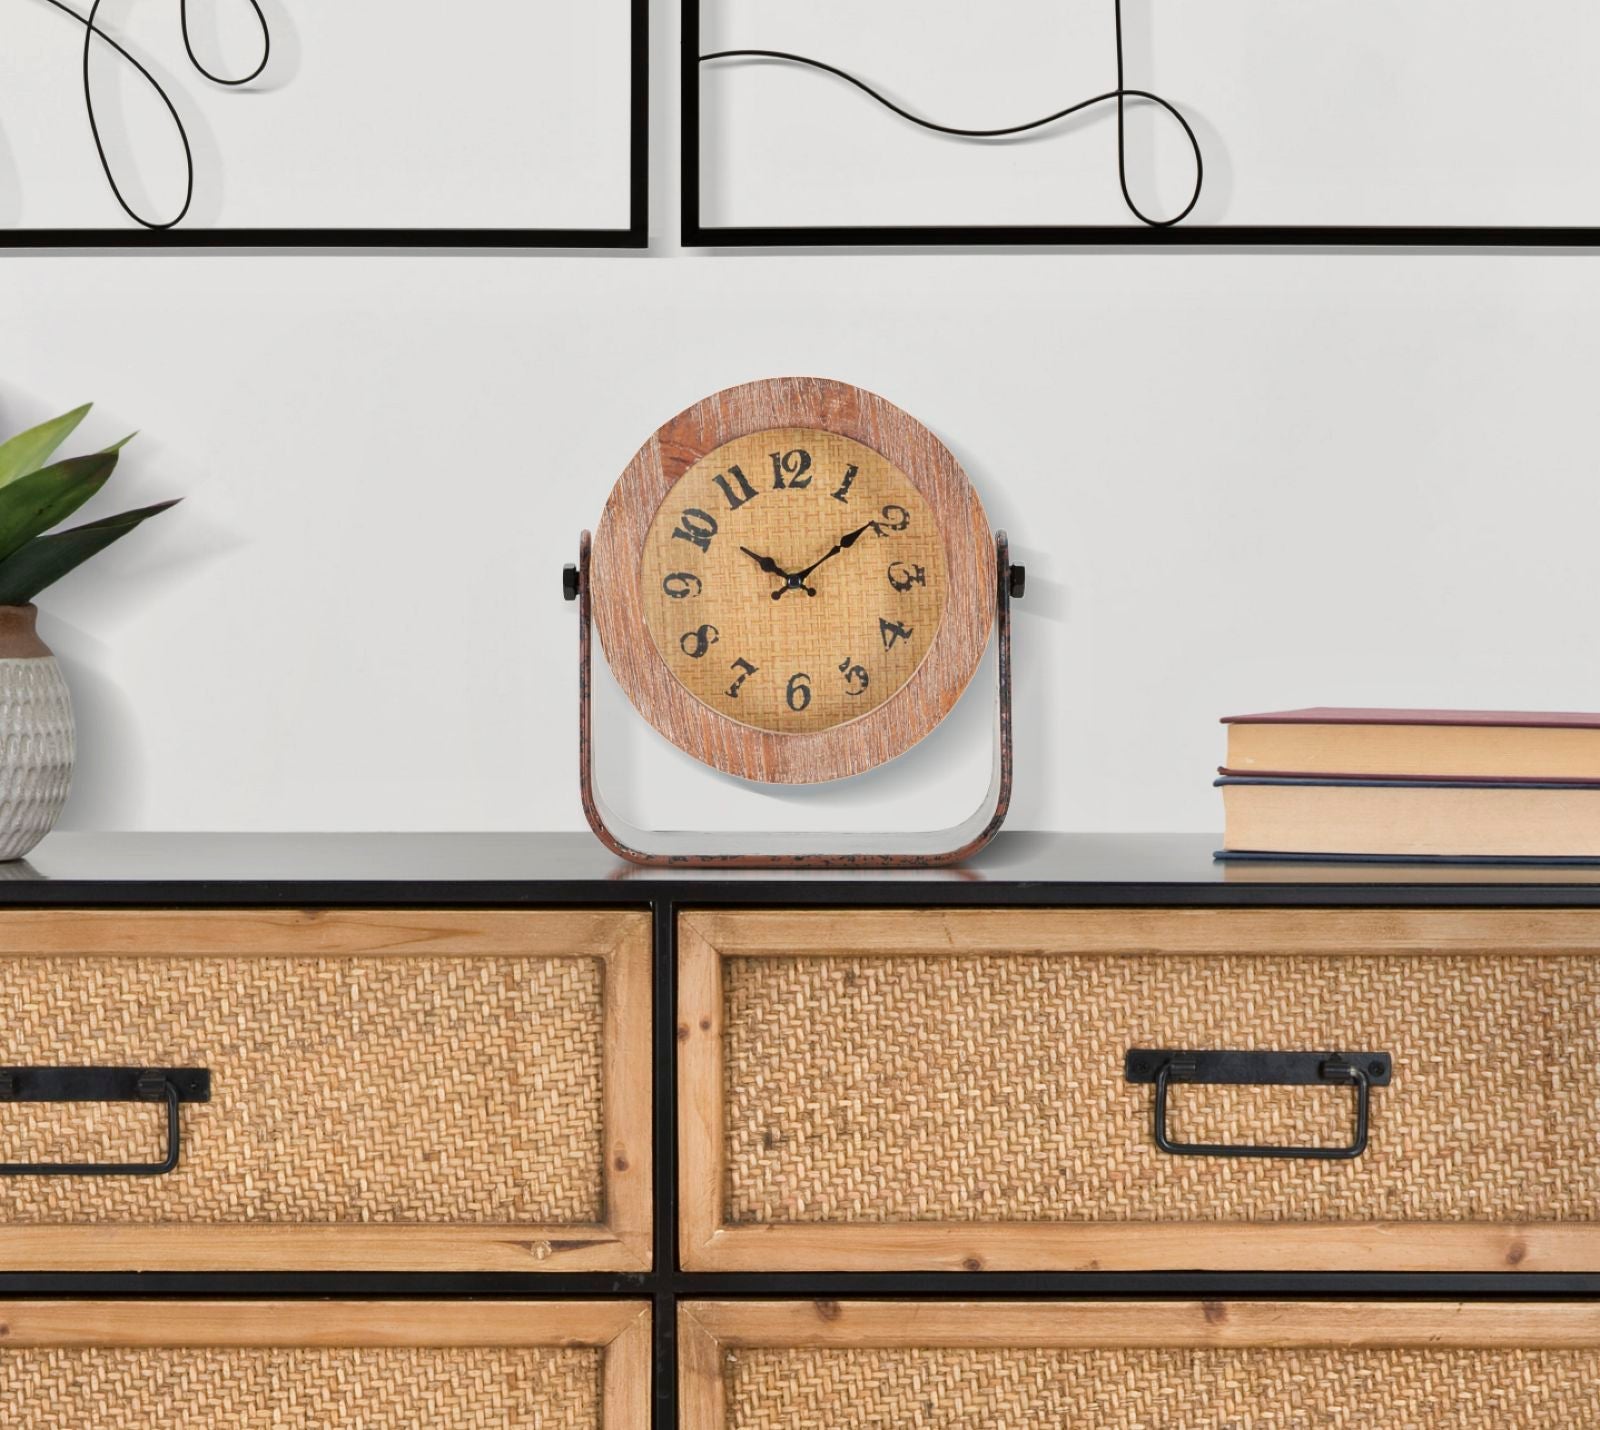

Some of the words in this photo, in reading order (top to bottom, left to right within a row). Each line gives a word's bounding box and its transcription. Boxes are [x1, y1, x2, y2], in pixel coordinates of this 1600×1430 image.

[712, 464, 759, 511] 11
[768, 448, 812, 490] 12
[830, 463, 859, 504] 1
[671, 507, 719, 553] 10
[871, 504, 911, 538] 2
[662, 571, 702, 599] 9
[887, 561, 927, 593] 3
[680, 623, 720, 659] 8
[879, 617, 914, 652] 4
[724, 657, 759, 698] 7
[786, 672, 812, 712] 6
[838, 656, 870, 696] 5
